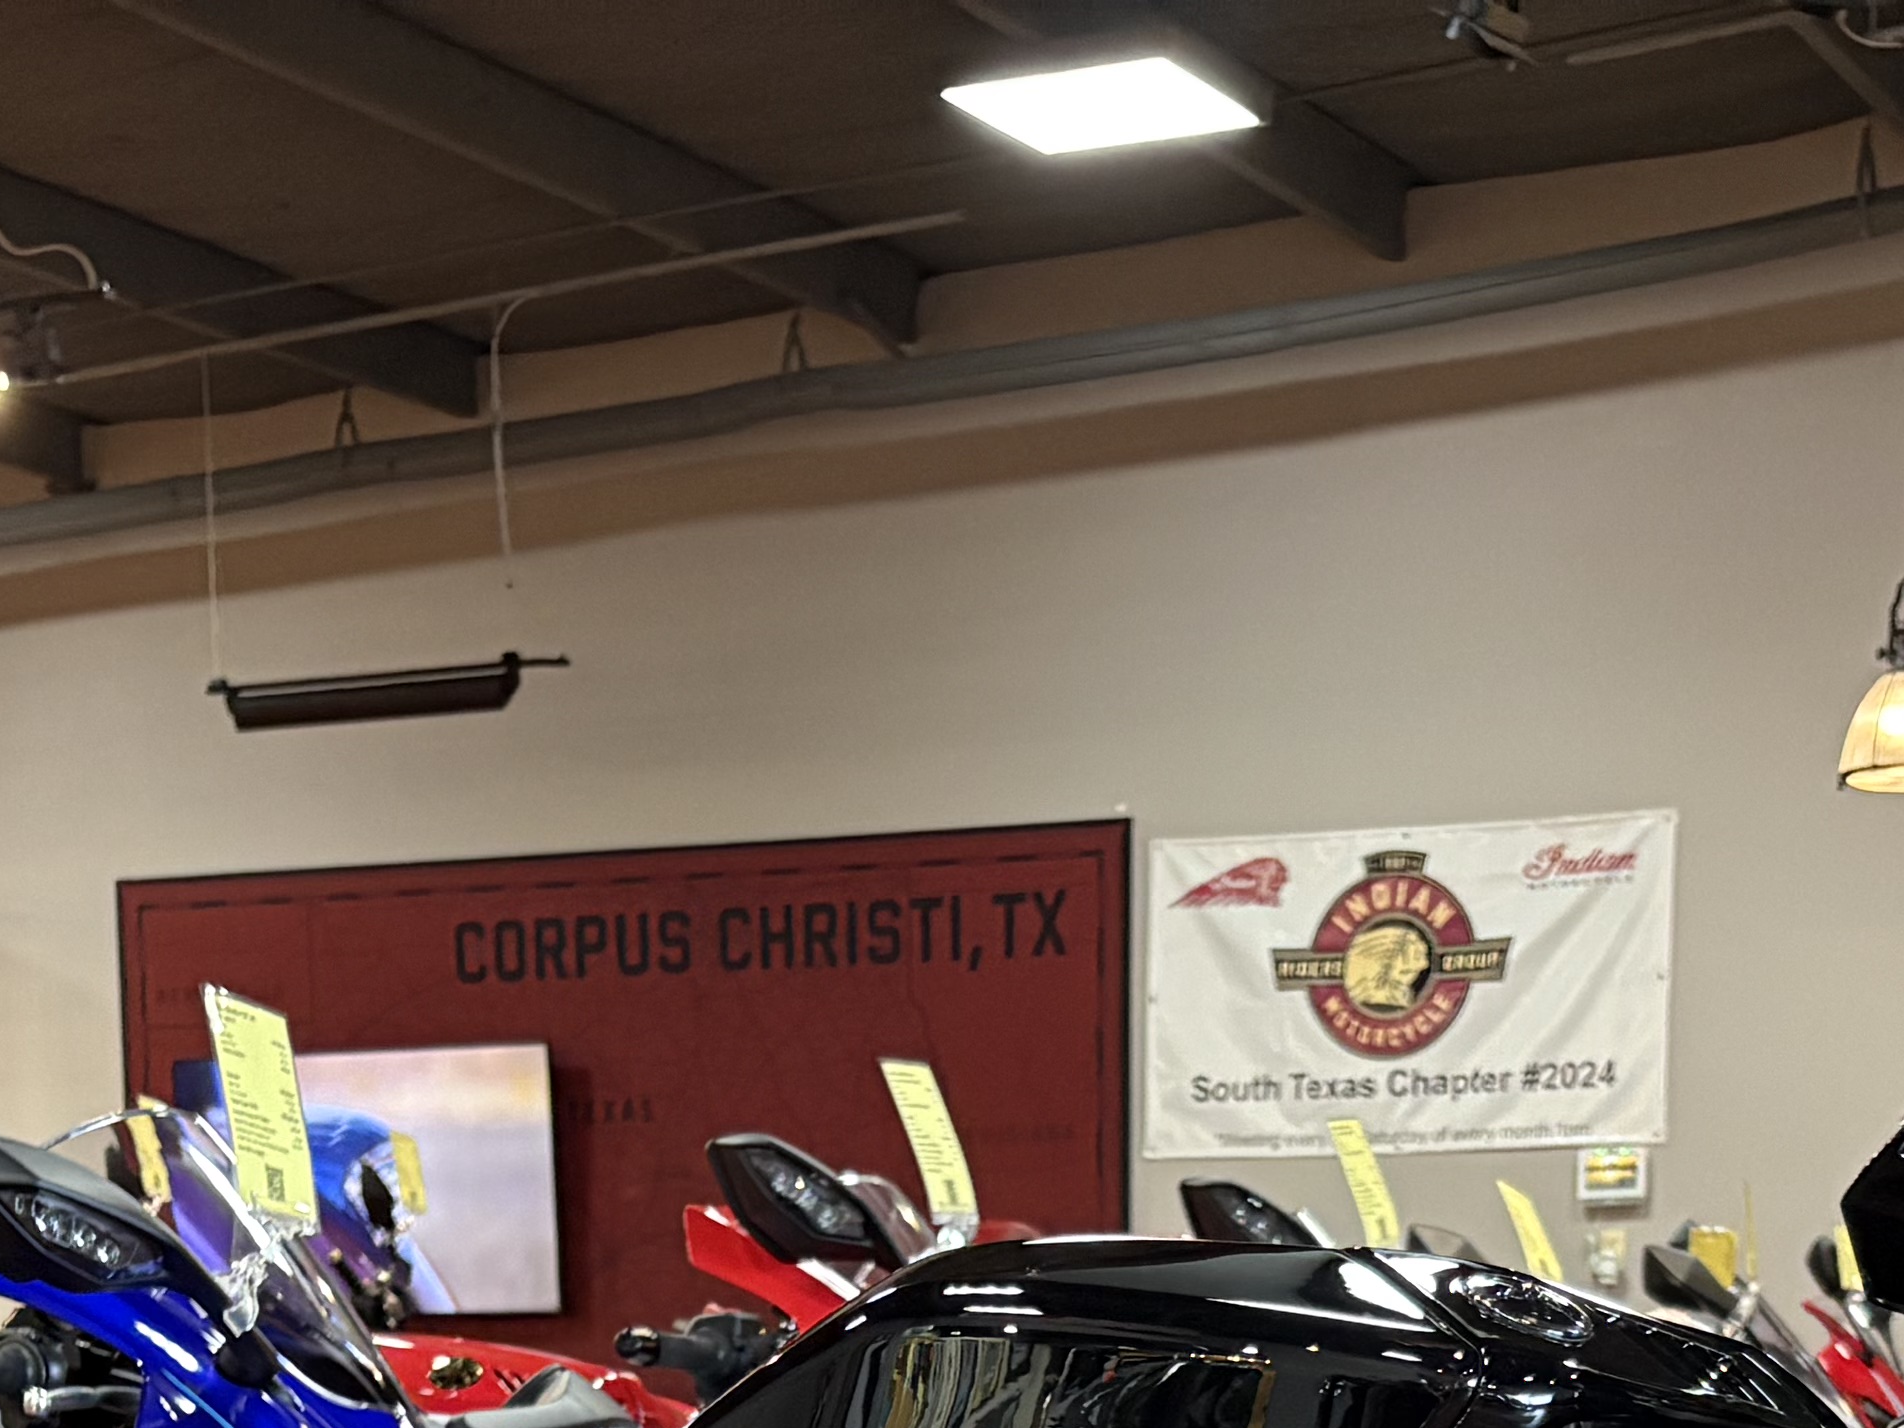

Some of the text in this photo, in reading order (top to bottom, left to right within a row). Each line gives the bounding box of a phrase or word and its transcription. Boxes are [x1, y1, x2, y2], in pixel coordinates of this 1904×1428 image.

[1522, 842, 1638, 880] Indian
[1331, 881, 1457, 934] INDIAN
[454, 909, 693, 984] CORPUS
[1191, 1060, 1617, 1103] South Texas Chapter #2024
